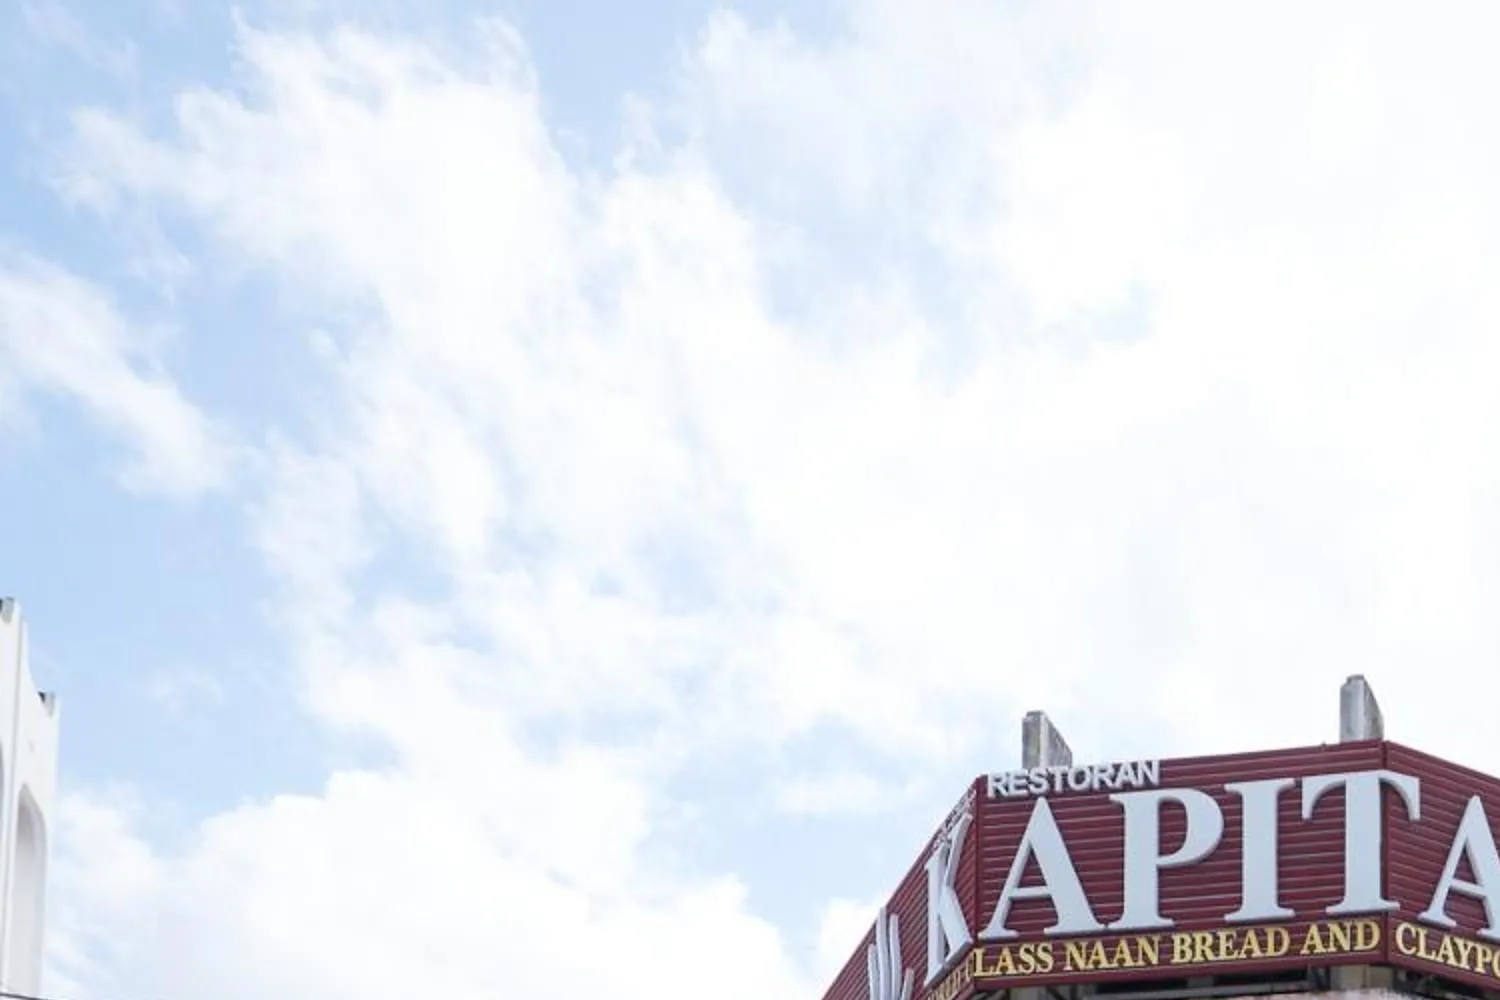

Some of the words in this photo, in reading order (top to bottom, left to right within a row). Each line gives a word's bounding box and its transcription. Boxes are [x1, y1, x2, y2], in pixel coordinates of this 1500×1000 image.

[986, 760, 1160, 799] RESTORAN
[1063, 933, 1161, 972] NAAN
[1170, 925, 1290, 966] BREAD
[1300, 918, 1382, 956] AND
